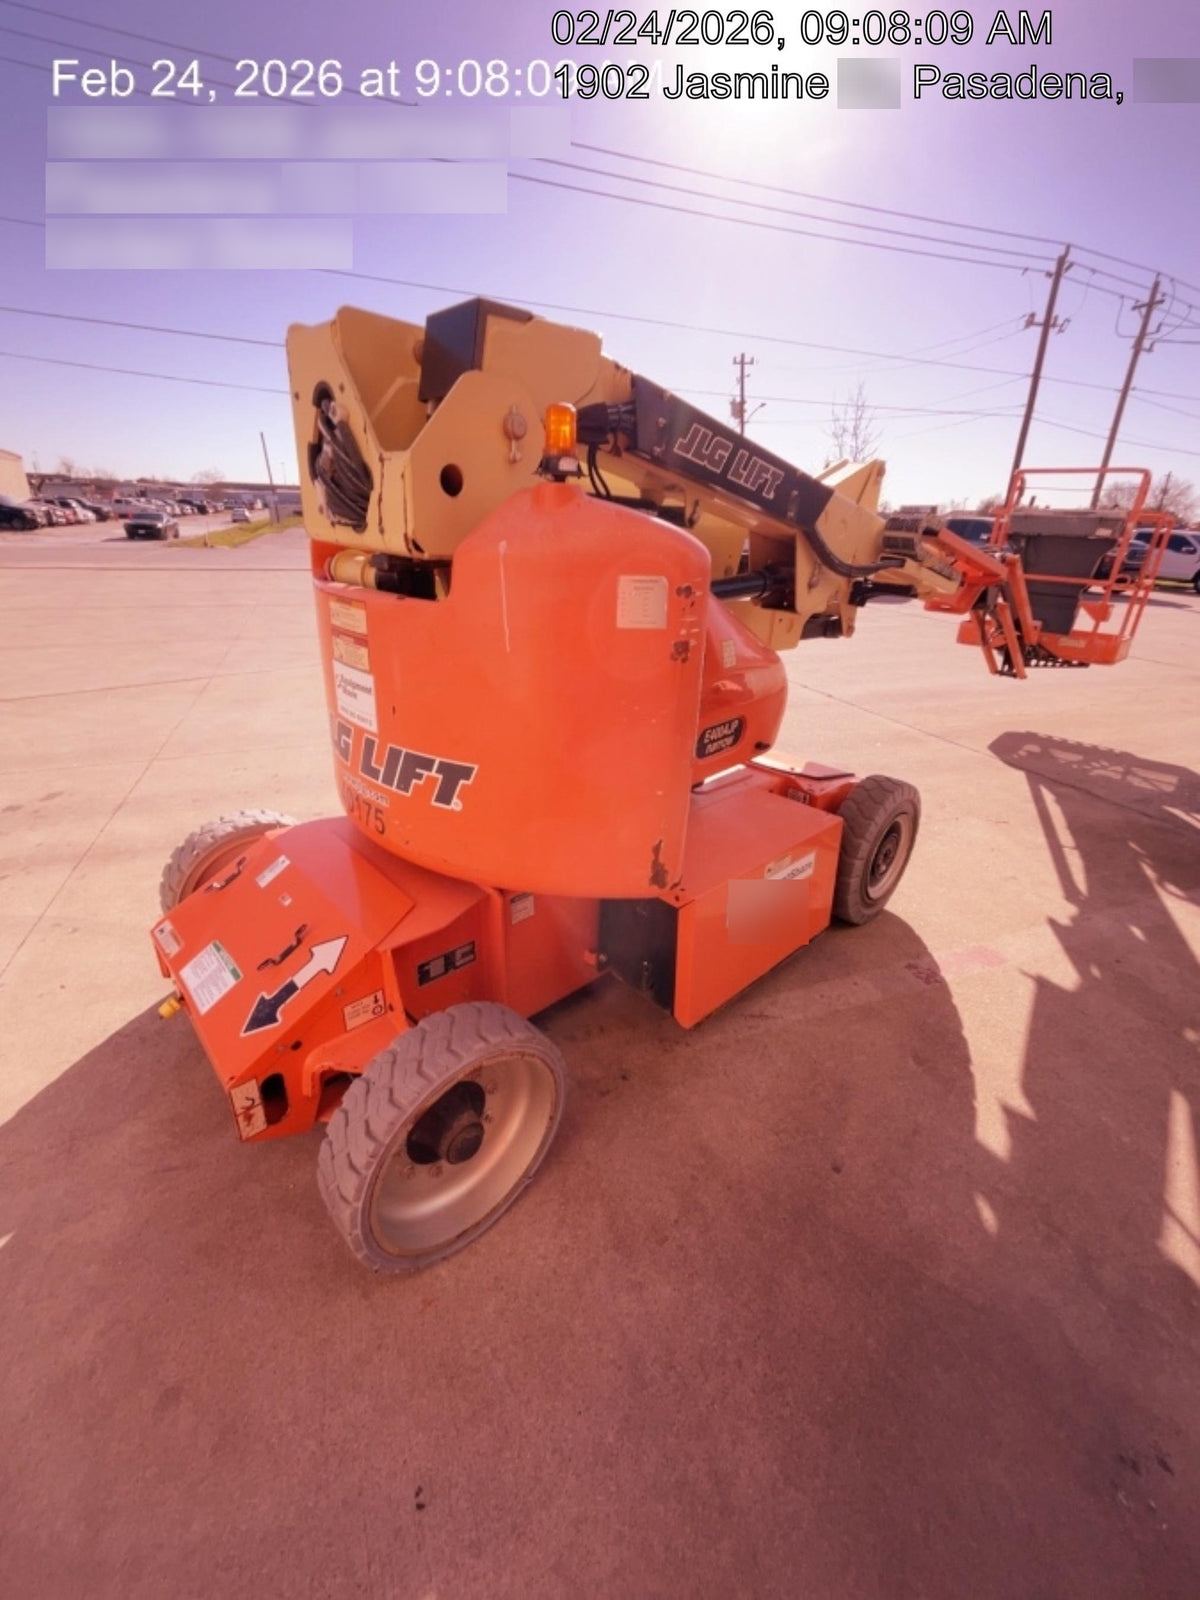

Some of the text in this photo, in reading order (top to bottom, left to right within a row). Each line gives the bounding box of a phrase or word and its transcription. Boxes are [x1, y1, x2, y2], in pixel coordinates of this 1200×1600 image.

[674, 422, 786, 500] JLG LIFT
[359, 733, 479, 810] LIFT
